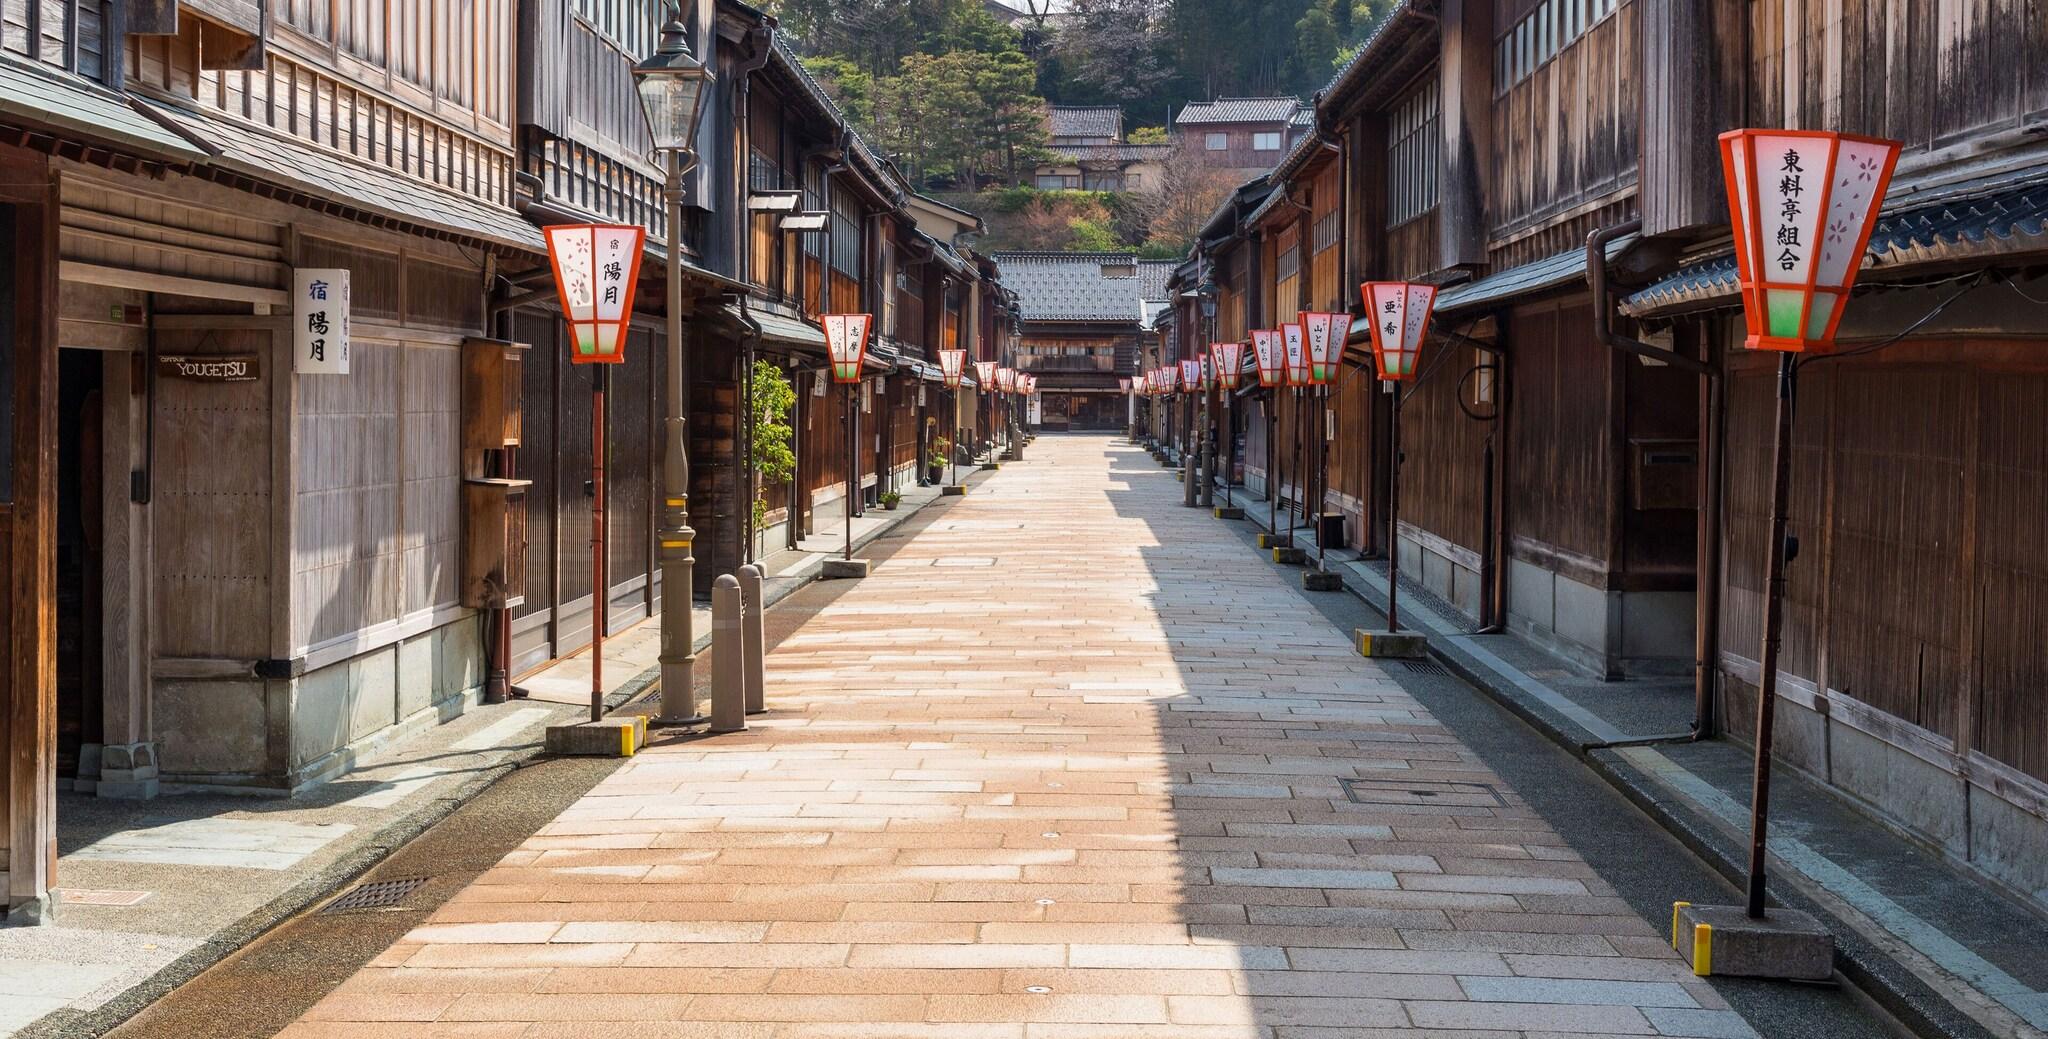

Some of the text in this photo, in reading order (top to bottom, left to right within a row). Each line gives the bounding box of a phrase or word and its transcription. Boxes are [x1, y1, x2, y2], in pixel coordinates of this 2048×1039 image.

[1776, 148, 1804, 271] 東料亭組合
[1384, 300, 1398, 336] 亜希
[1314, 324, 1322, 353] 山とみ
[177, 361, 247, 377] YOUGETSU
